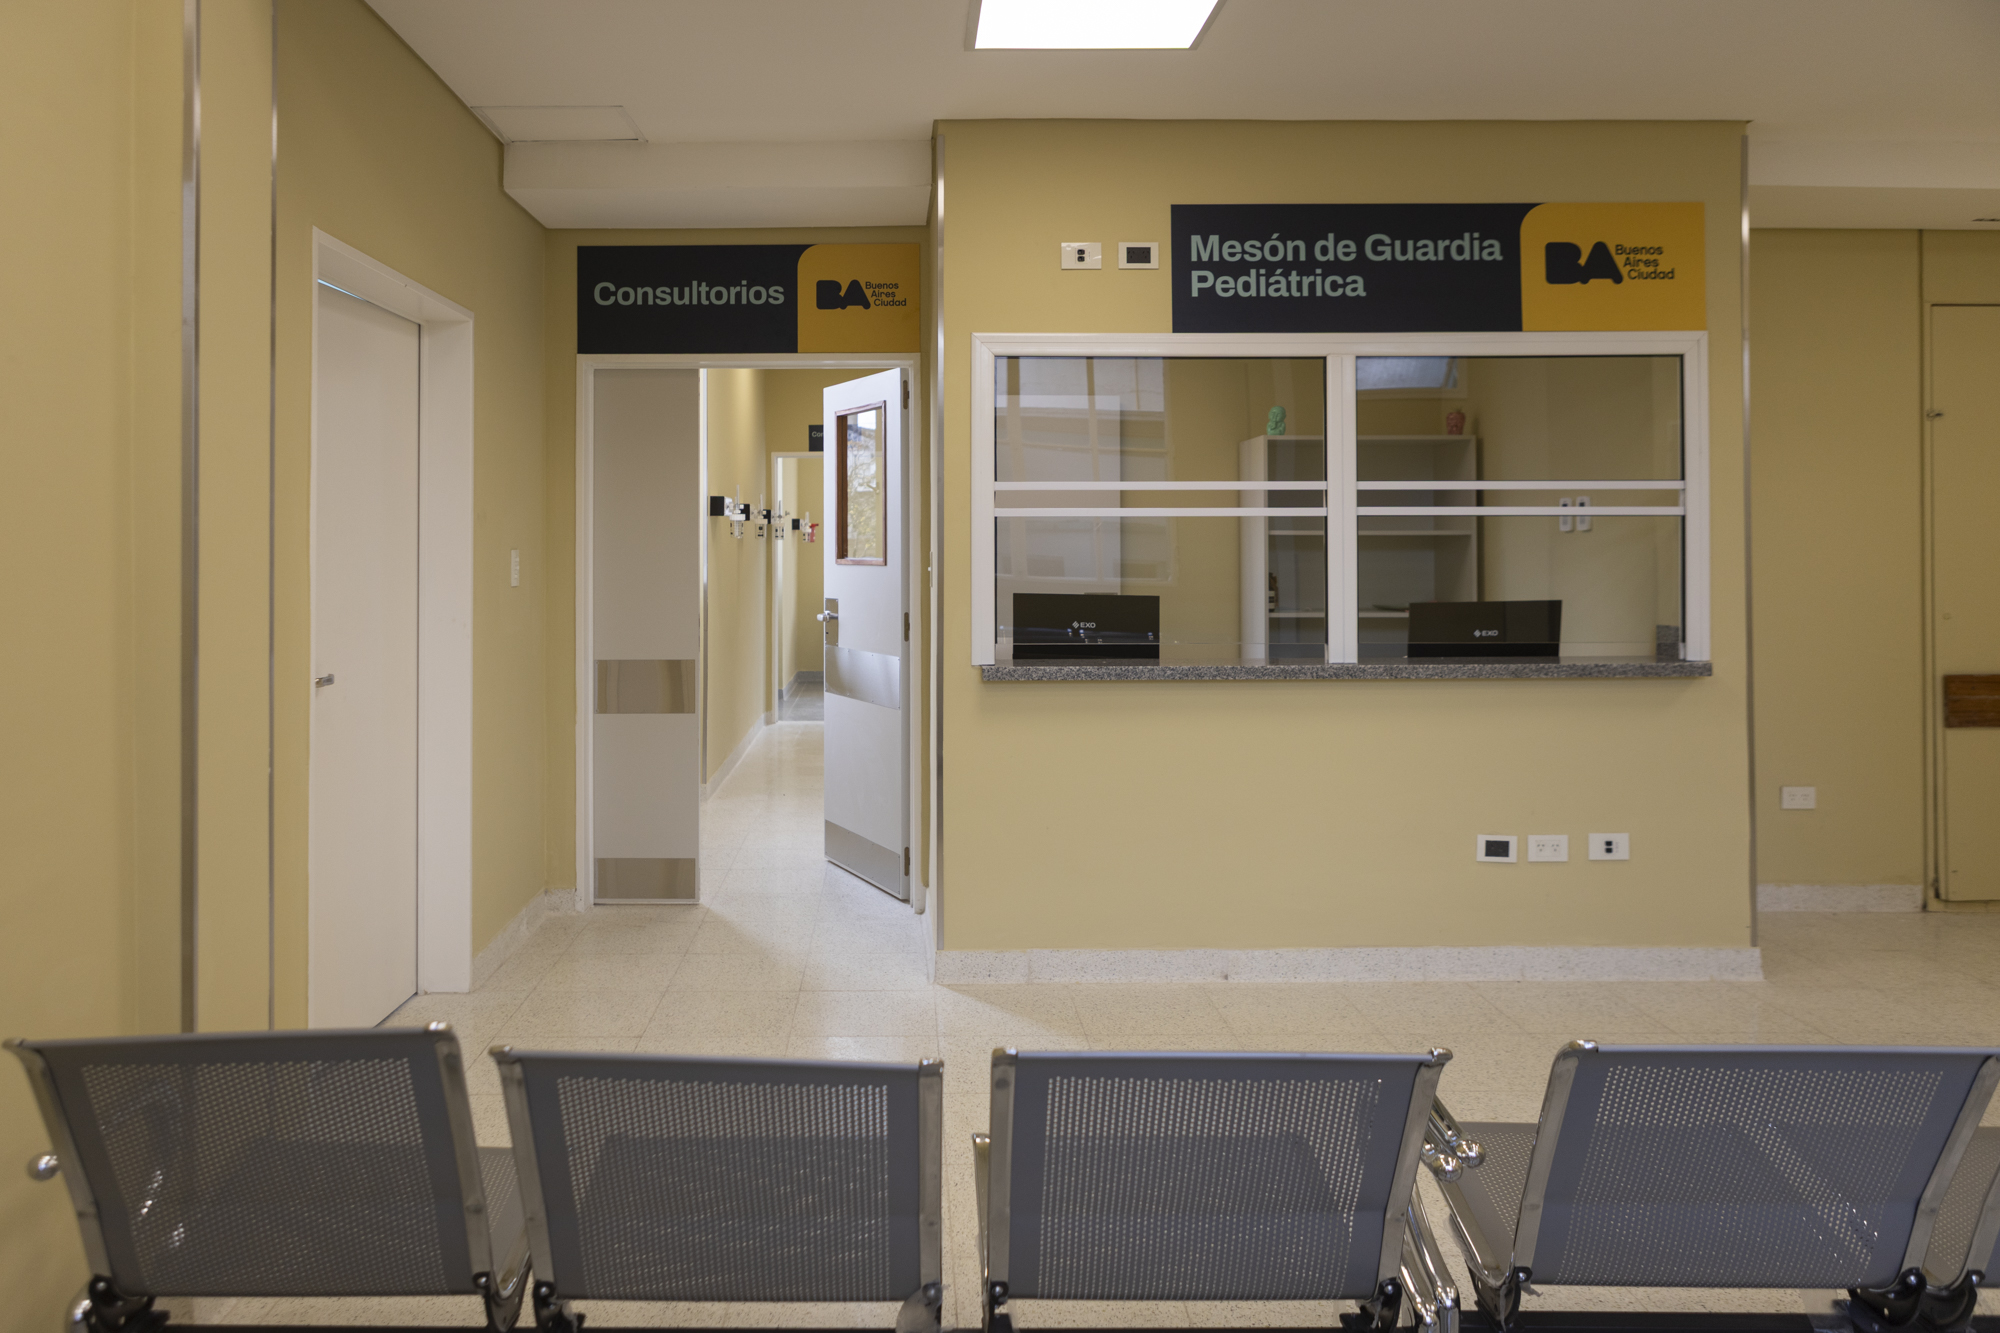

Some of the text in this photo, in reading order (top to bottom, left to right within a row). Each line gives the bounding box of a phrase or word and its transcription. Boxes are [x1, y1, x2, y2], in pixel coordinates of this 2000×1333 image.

[1190, 232, 1503, 262] Mesón de Guardia
[1615, 244, 1664, 256] Buenos
[1545, 241, 1623, 285] BA
[1623, 256, 1660, 268] Aires
[1627, 267, 1676, 280] Ciudad
[865, 281, 899, 290] Buenos
[1191, 267, 1368, 298] Pediátrica
[593, 280, 786, 306] Consultorios
[816, 279, 871, 310] BA
[871, 289, 896, 298] Aires
[874, 298, 907, 307] Ciudad
[1080, 621, 1097, 629] EXO
[1481, 629, 1499, 637] EXO
